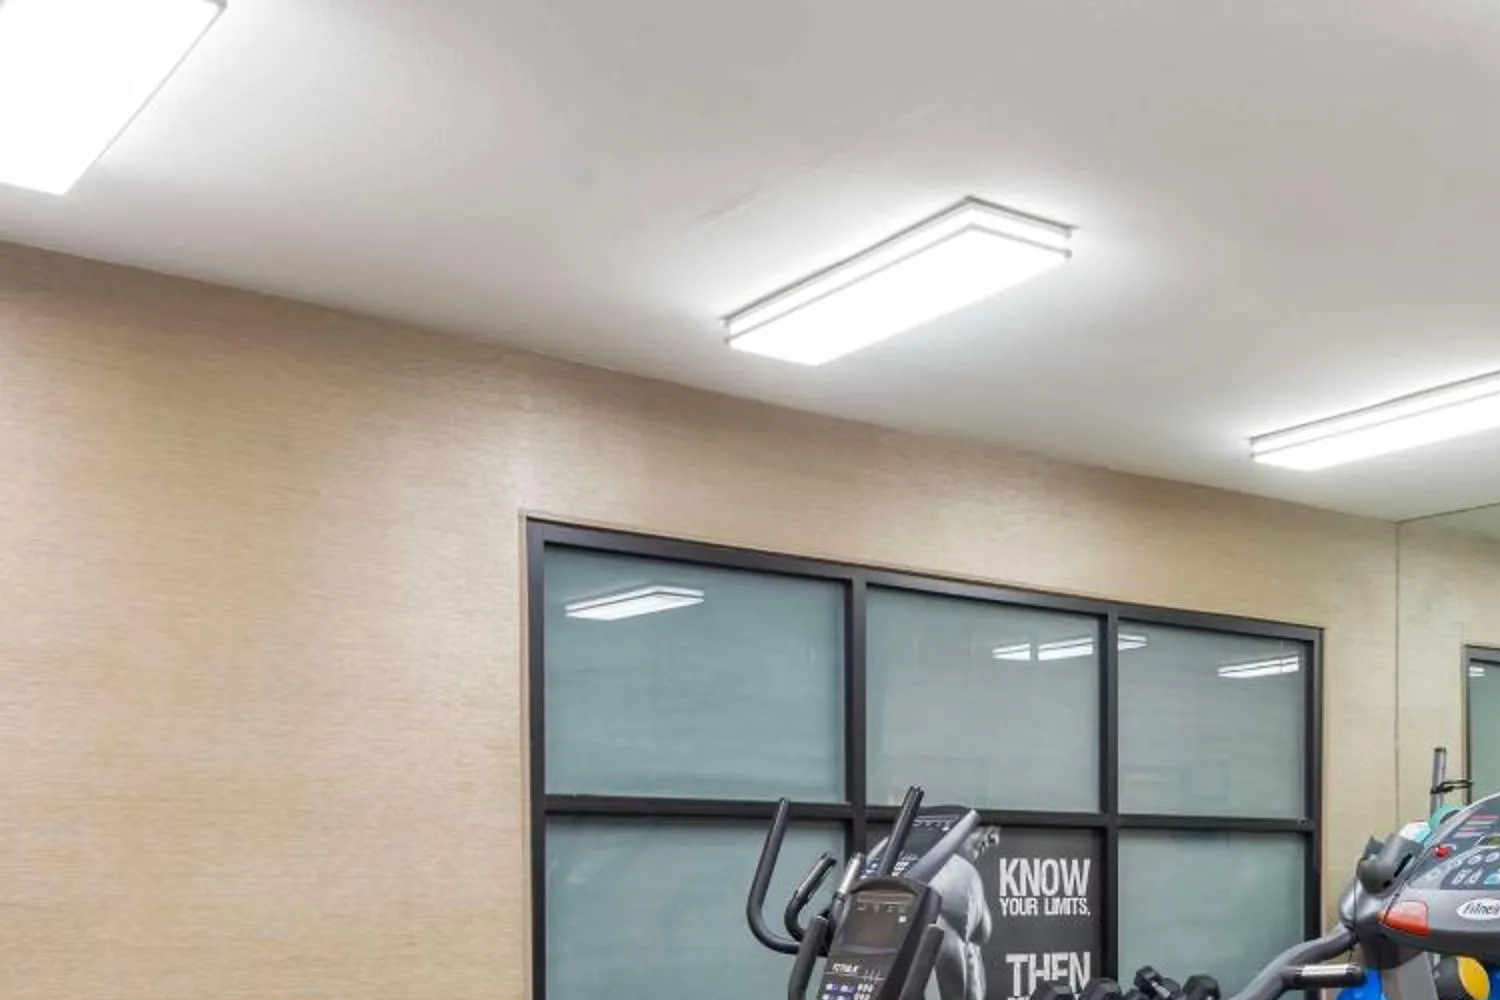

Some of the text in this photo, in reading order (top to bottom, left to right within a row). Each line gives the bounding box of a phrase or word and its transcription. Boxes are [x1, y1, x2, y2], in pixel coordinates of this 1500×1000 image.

[999, 857, 1091, 897] KNOW
[1000, 897, 1039, 916] YOUR
[1005, 951, 1091, 997] THEN
